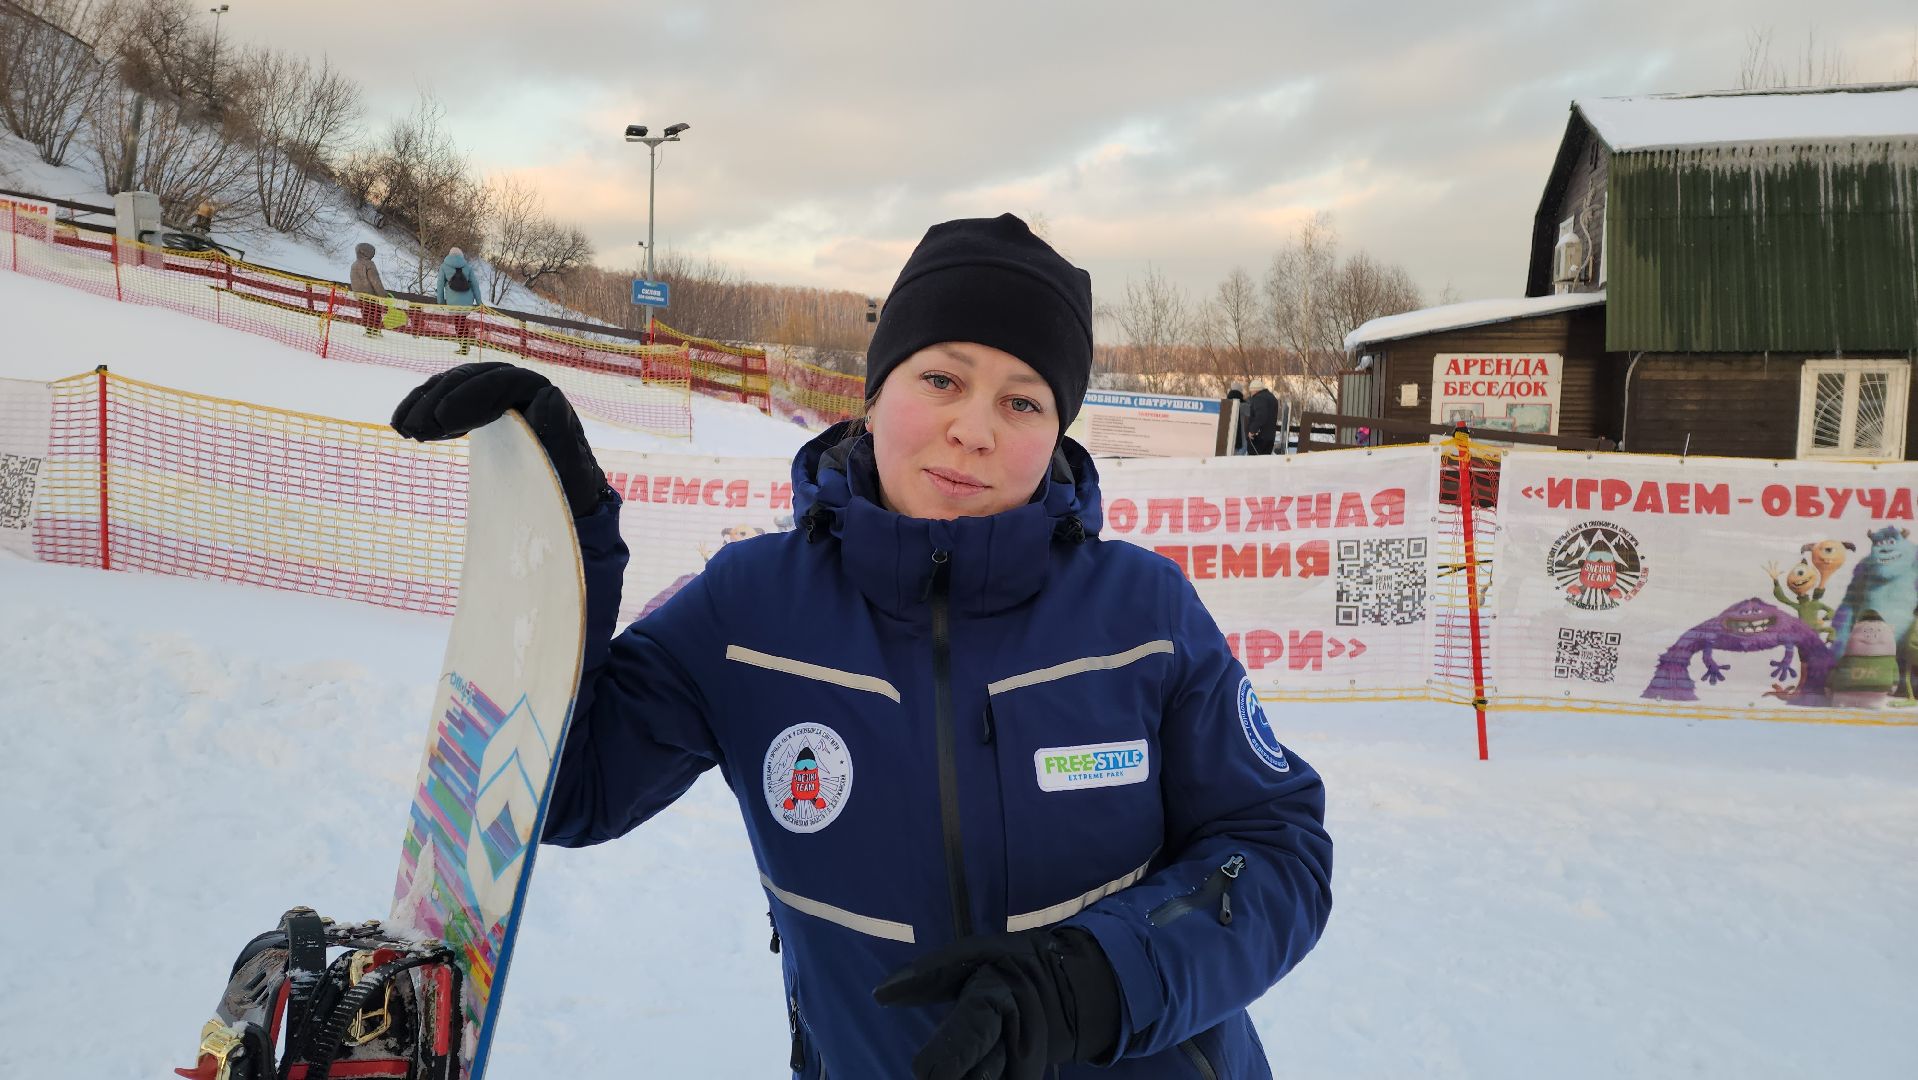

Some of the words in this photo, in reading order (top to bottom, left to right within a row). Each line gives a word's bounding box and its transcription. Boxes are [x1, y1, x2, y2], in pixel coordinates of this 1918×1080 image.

[1444, 358, 1549, 379] АРЕНДА
[1443, 381, 1548, 399] БЕСЕДОК
[1101, 488, 1406, 534] ОЛЫЖНАЯ
[1587, 572, 1612, 582] TEAM
[1068, 773, 1104, 782] EXTREME
[1106, 770, 1125, 779] PARK
[795, 783, 816, 793] TEAM
